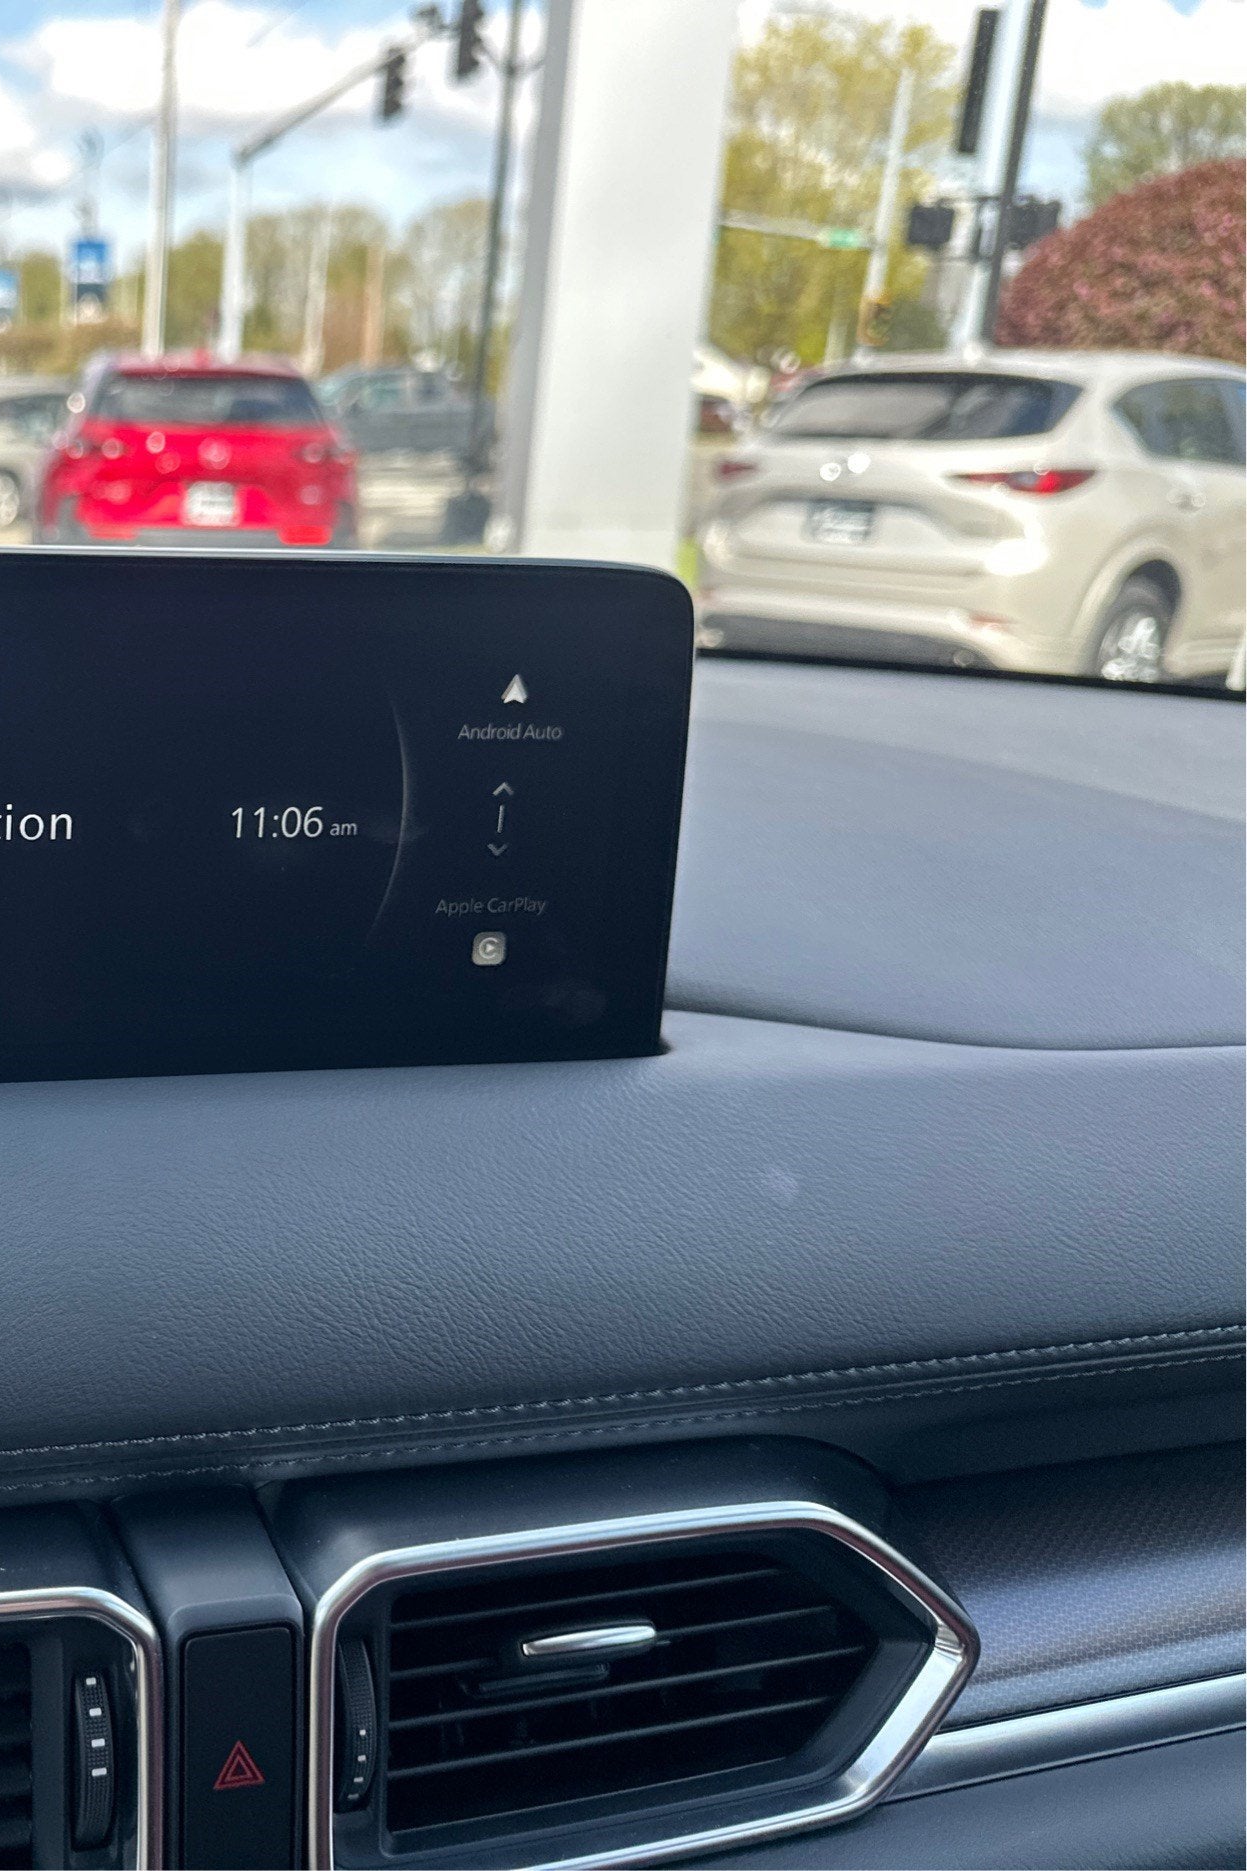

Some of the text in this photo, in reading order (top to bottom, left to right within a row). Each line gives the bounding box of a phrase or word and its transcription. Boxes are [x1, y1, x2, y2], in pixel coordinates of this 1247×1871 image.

[457, 722, 563, 740] Android Auto
[231, 806, 358, 839] 11:06 am
[434, 896, 546, 917] Apple CarPlay
